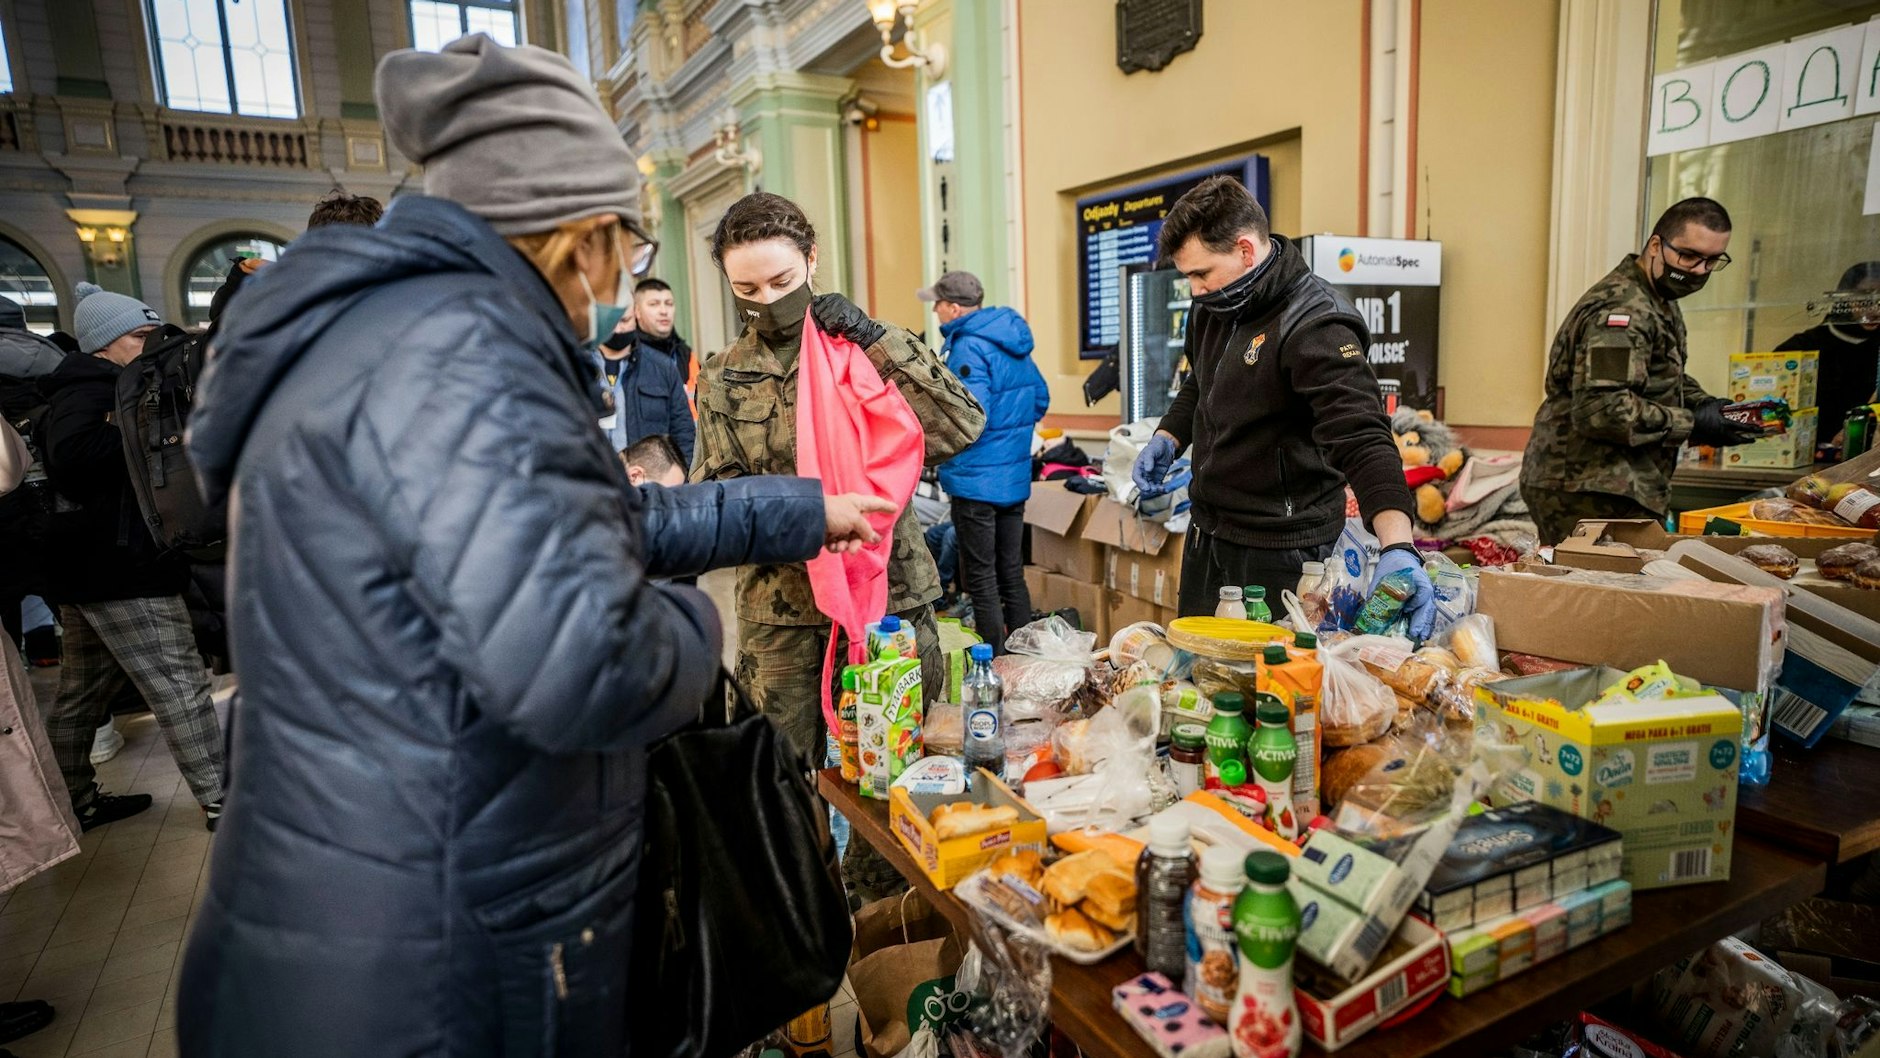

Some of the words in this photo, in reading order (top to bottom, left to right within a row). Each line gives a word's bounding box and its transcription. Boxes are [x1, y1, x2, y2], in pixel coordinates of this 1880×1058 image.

[1083, 202, 1119, 221] Odjazdy
[1124, 195, 1164, 212] Departures
[1358, 254, 1420, 269] AutomatSpec
[1355, 297, 1385, 334] NR
[1387, 290, 1401, 334] 1
[1366, 340, 1410, 364] OLSCE
[889, 667, 922, 716] TYMBARK
[1687, 724, 1712, 735] GRATIS
[1256, 750, 1297, 761] ACTIVIA
